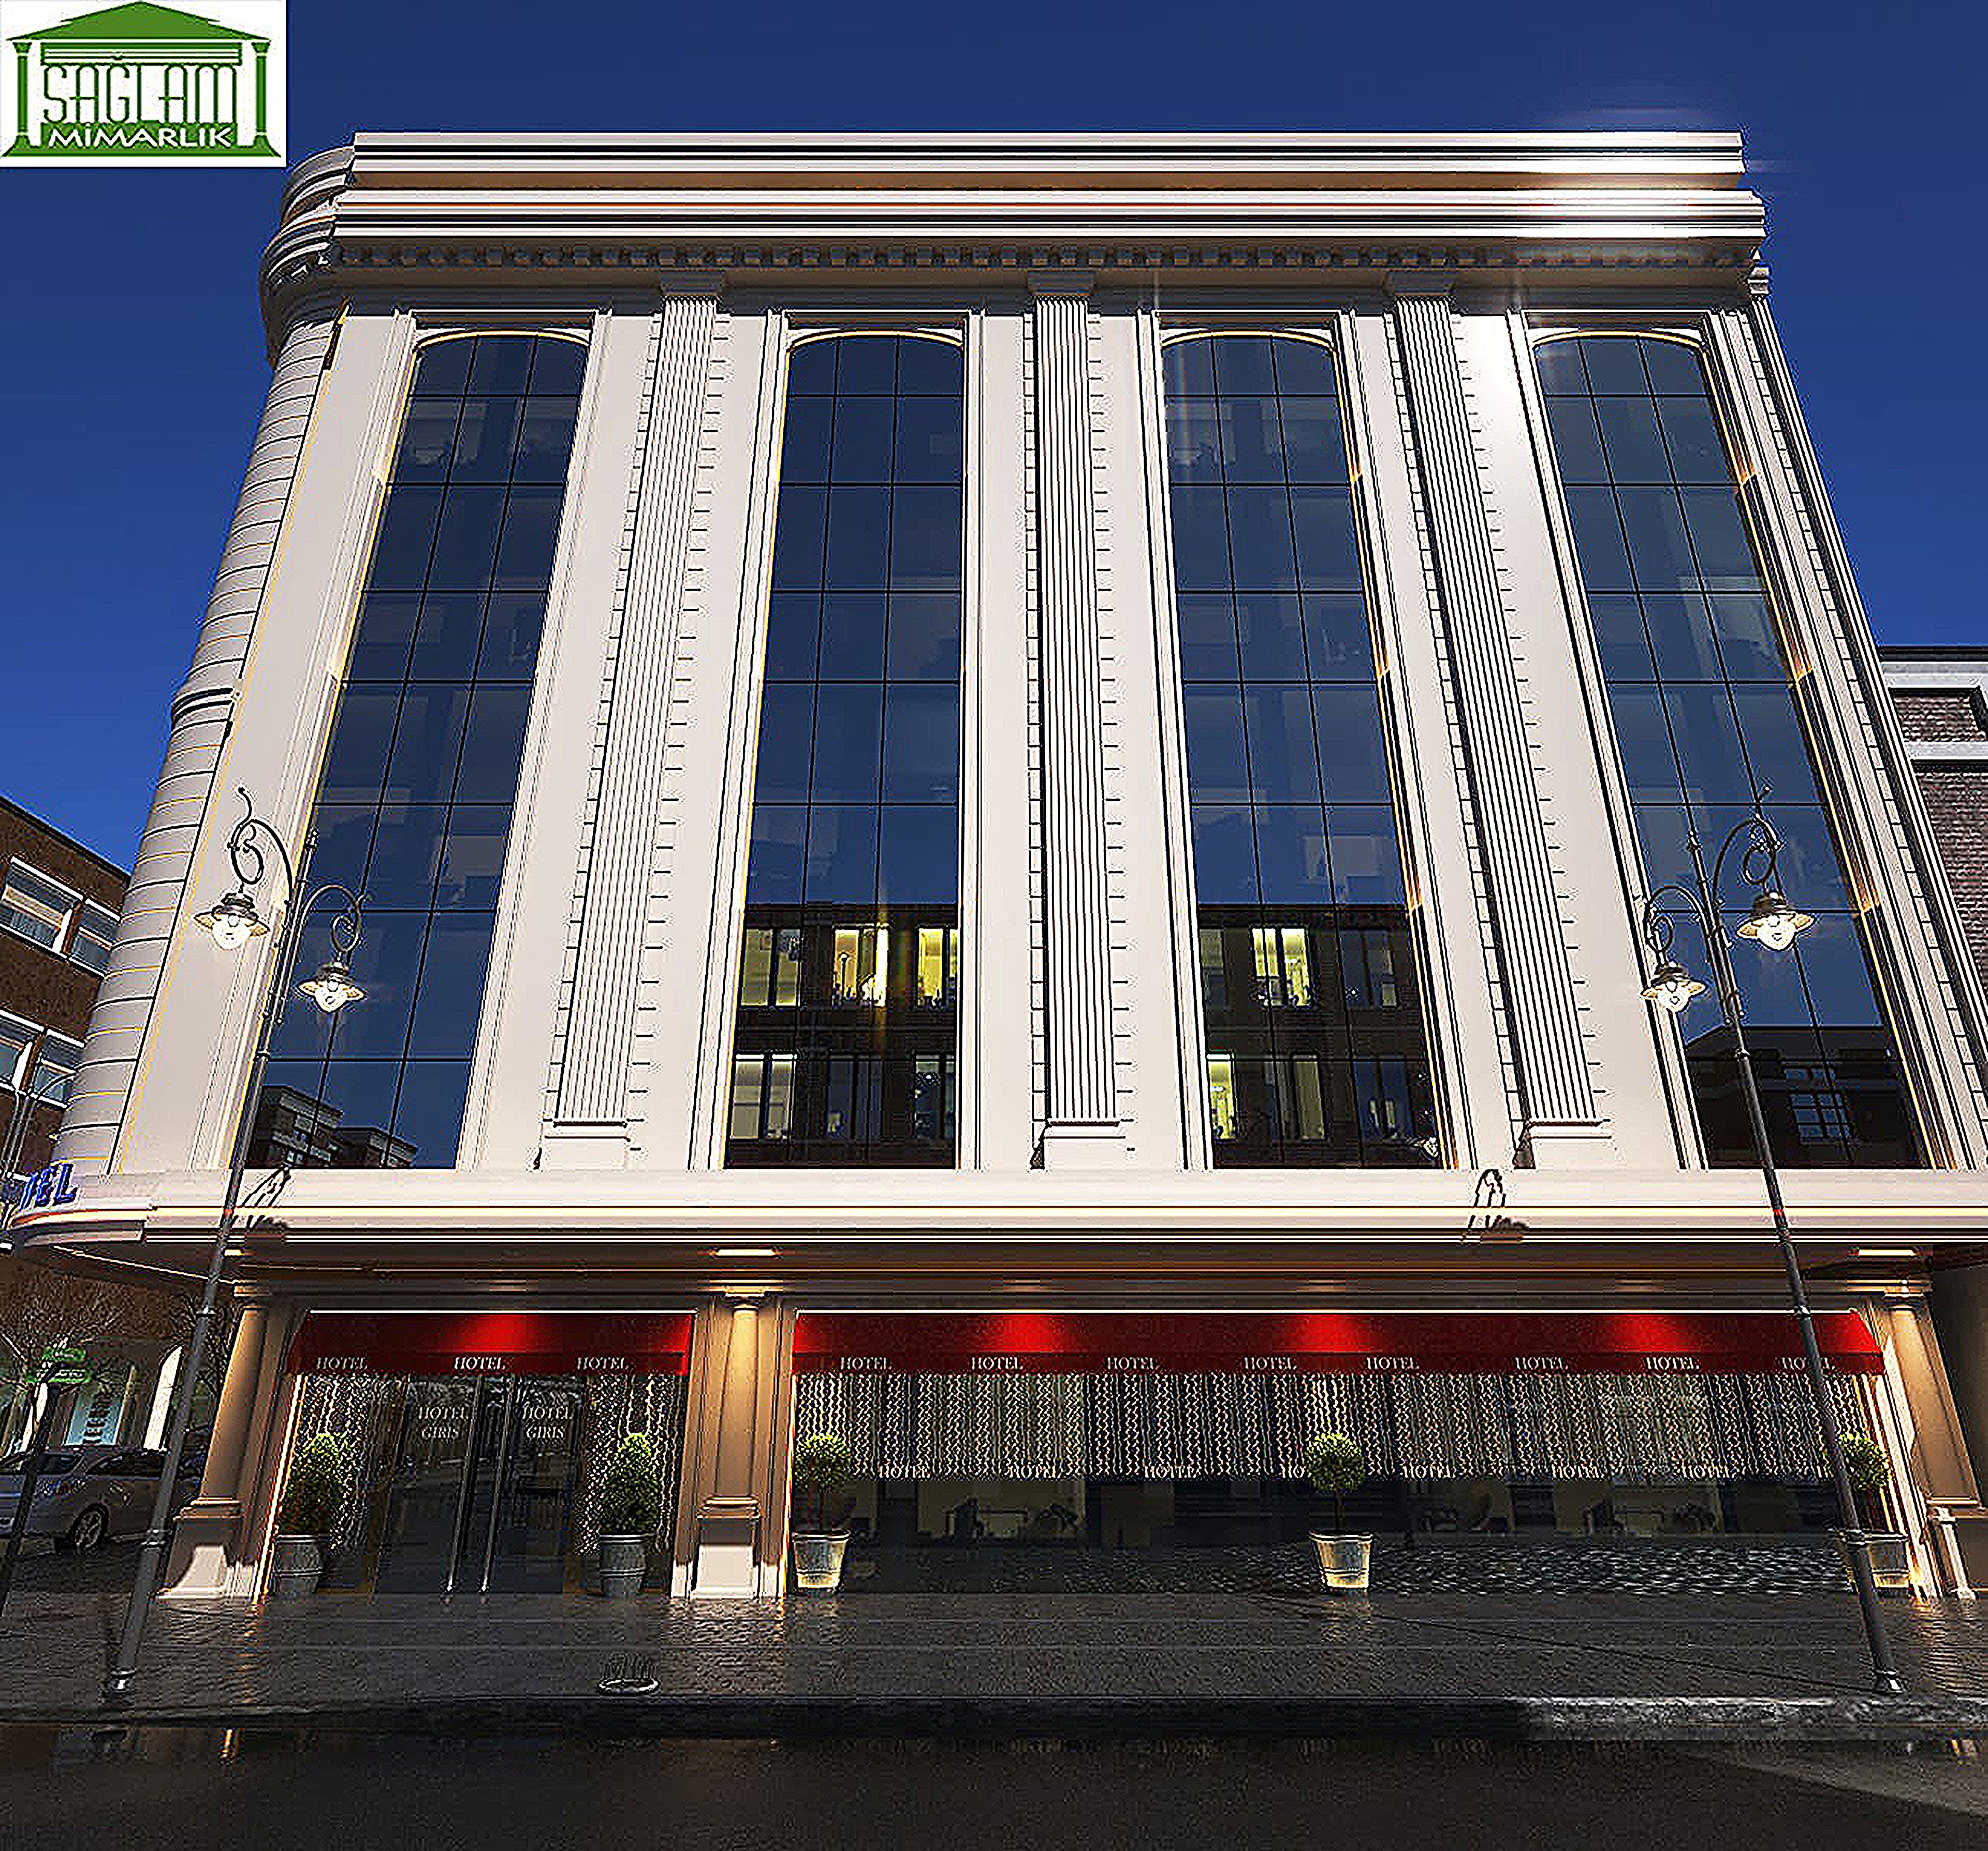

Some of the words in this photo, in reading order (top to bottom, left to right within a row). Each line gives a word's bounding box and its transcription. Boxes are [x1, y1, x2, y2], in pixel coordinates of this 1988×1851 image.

[315, 1357, 368, 1370] HOTEL
[453, 1357, 508, 1370] HOTEL
[576, 1357, 630, 1370] HOTEL
[840, 1357, 891, 1370] HOTEL
[971, 1357, 1023, 1370] HOTEL
[1106, 1357, 1159, 1370] HOTEL
[1244, 1357, 1297, 1370] HOTEL
[1366, 1357, 1420, 1370] HOTEL
[1515, 1357, 1569, 1370] HOTEL
[1646, 1357, 1700, 1370] HOTEL
[418, 1405, 470, 1419] HOTEL
[522, 1405, 573, 1419] HOTEL
